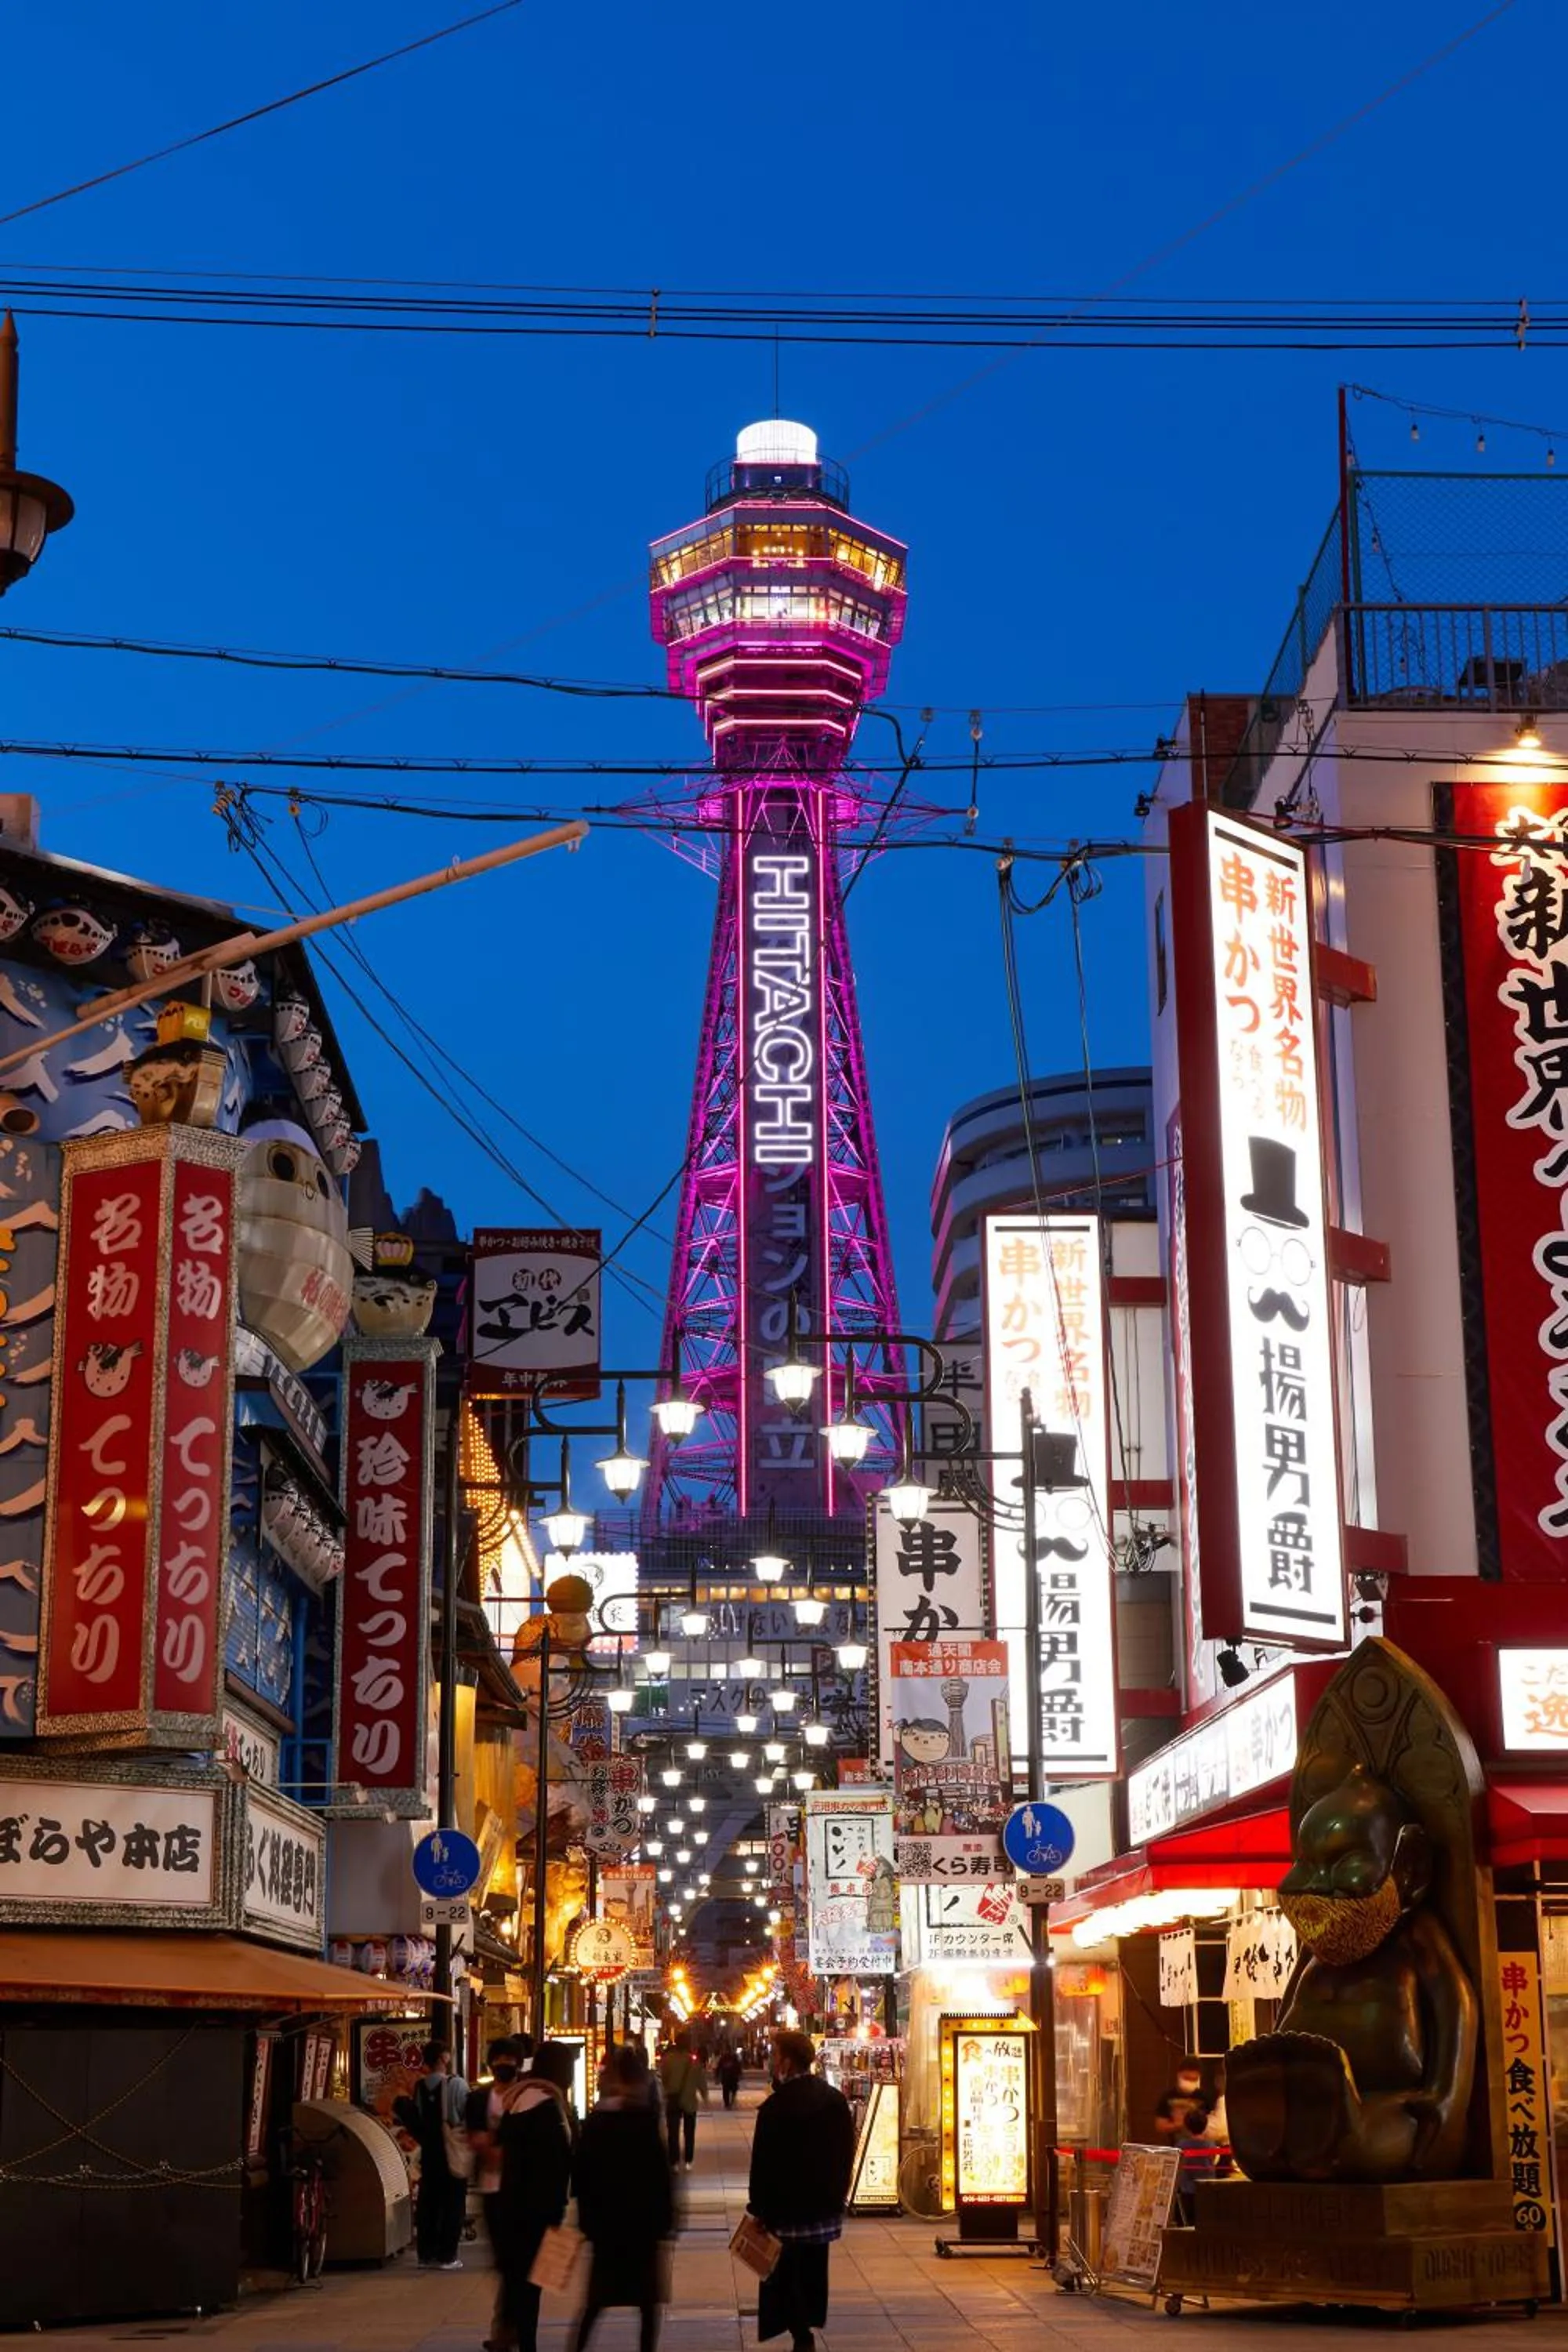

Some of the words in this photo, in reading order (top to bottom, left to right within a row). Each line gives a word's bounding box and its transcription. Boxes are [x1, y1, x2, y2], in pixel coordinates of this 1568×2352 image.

[753, 855, 813, 1163] HITACHI
[1219, 851, 1261, 1033] 串かつ
[1263, 867, 1307, 1132] 新世界名物
[87, 1192, 142, 1320] 名物
[176, 1192, 224, 1321] 名物
[477, 1293, 596, 1340] エビス
[999, 1237, 1042, 1363] 串かつ
[1052, 1238, 1091, 1421] 新世界名物
[1259, 1336, 1315, 1594] 揚男爵
[899, 1659, 1002, 1675] 南本通り商店会
[932, 1856, 1013, 1875] くら寿司
[1501, 1962, 1543, 2199] 串かつ食べ放題
